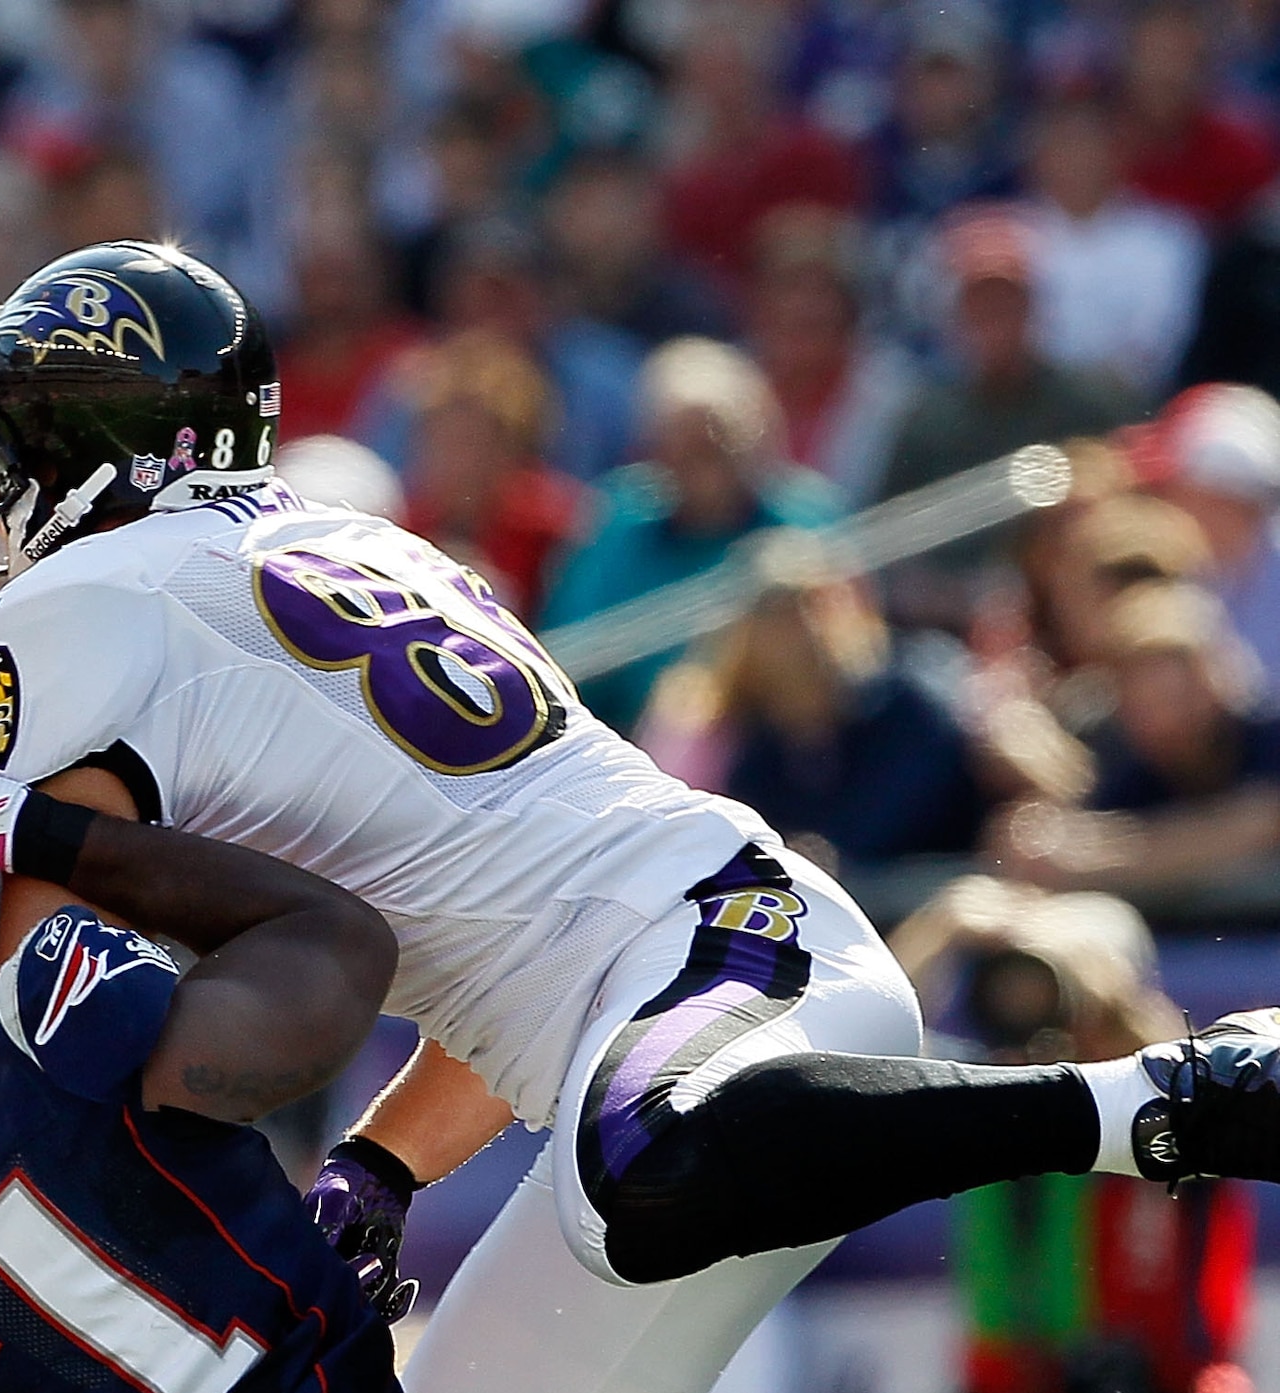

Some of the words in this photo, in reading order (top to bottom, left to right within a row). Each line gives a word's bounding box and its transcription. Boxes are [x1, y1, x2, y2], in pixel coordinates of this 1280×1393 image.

[51, 277, 112, 327] B
[24, 515, 67, 563] Riddell
[705, 887, 806, 942] B
